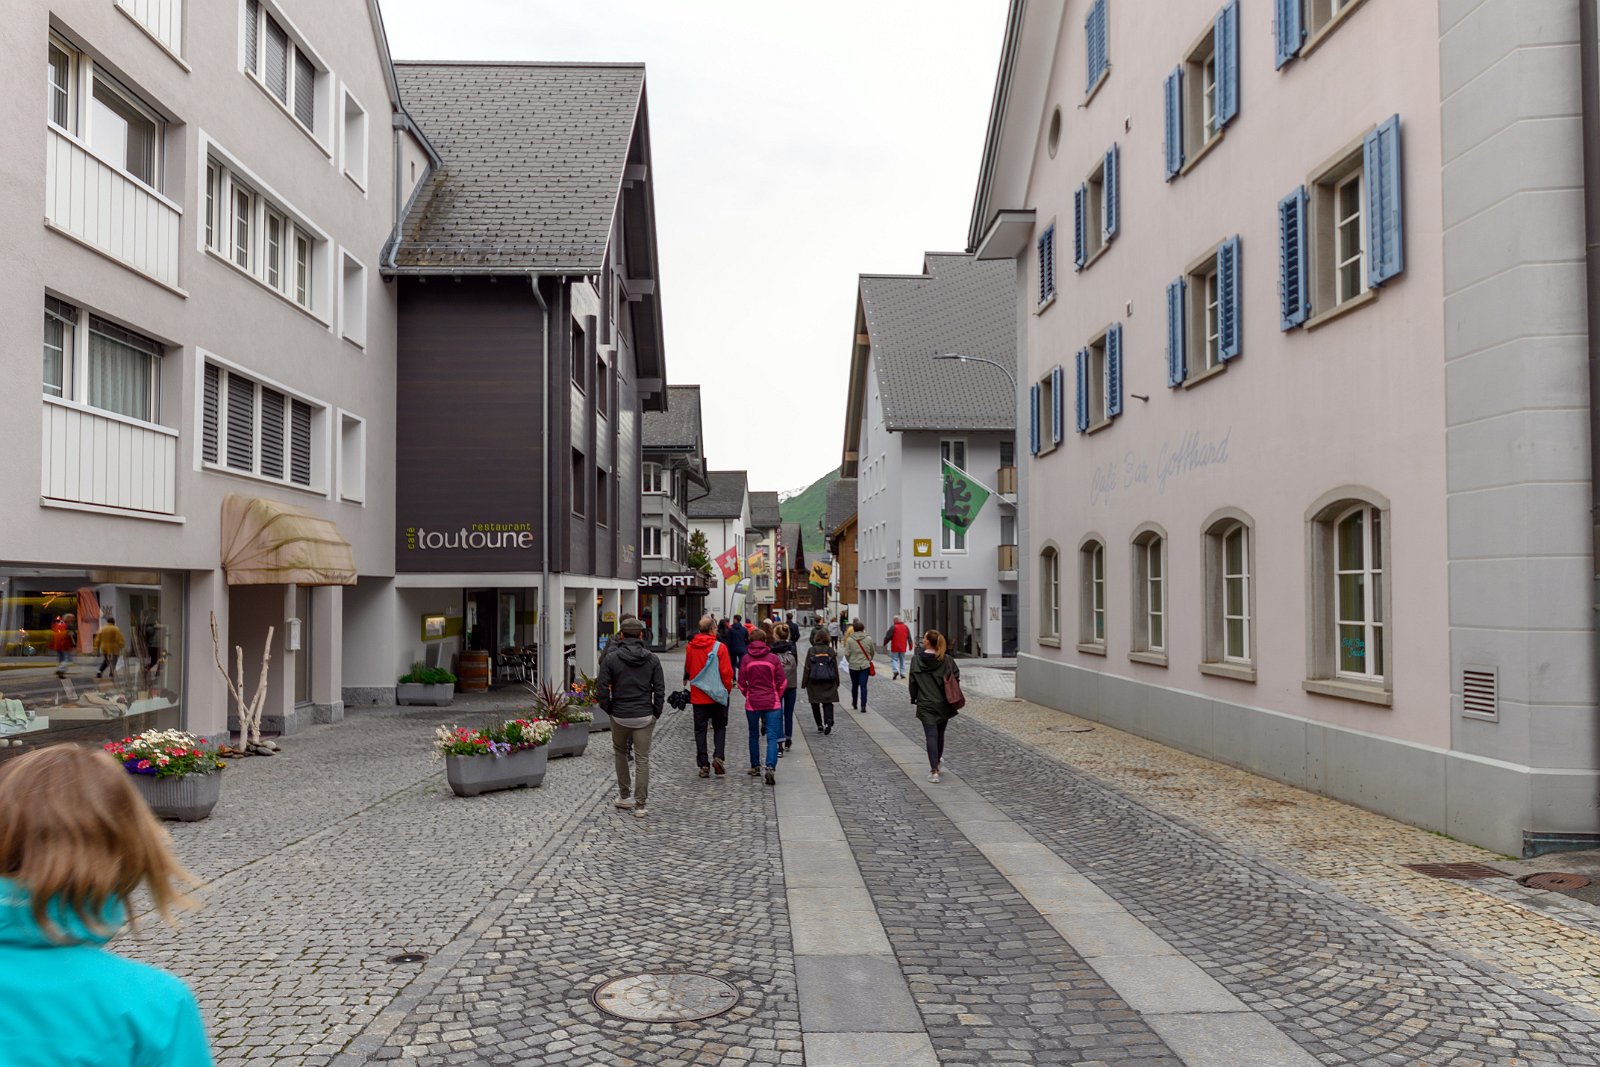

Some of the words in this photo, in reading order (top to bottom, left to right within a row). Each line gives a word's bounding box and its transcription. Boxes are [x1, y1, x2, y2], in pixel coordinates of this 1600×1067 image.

[1123, 450, 1149, 488] Bar
[1157, 425, 1232, 495] Gotthard
[472, 522, 532, 532] restaurant
[417, 527, 534, 550] toutoune
[913, 560, 952, 569] HOTEL
[637, 575, 695, 588] SPORT
